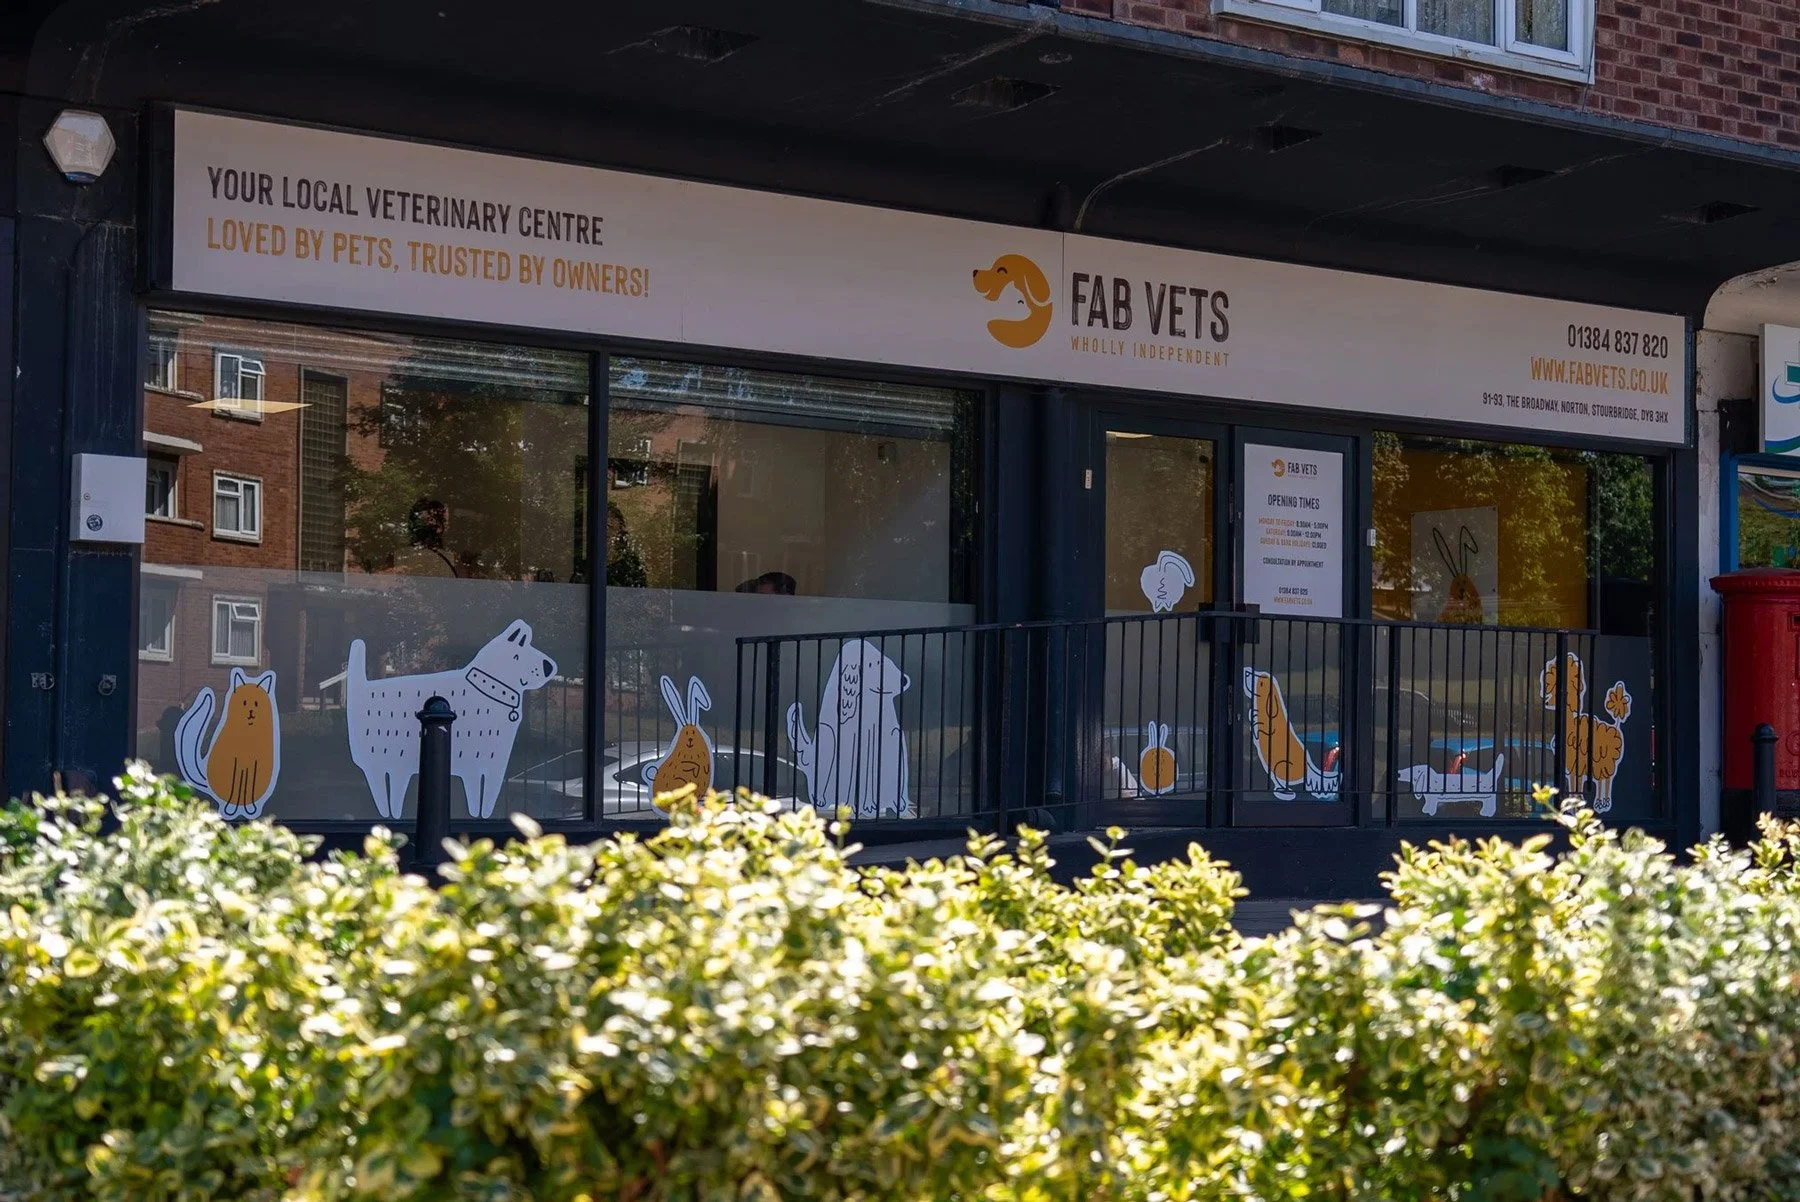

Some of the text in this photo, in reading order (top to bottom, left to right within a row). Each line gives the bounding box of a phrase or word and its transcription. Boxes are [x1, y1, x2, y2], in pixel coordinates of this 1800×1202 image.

[207, 166, 603, 246] YOUR LOCAL VETERINARY CENTRE
[207, 217, 649, 298] LOVED BY PETS, TRUSTED BY OWNERS!
[1072, 272, 1229, 343] FAB VETS
[1071, 336, 1230, 367] WHOLLY INDEPENDENT
[1568, 324, 1668, 359] 01384 837 820
[1531, 356, 1668, 395] WWW.FABVETS.CO.UK
[1506, 395, 1520, 408] THE
[1521, 396, 1560, 413] BROADWAY,
[1561, 400, 1590, 416] NORTON,
[1592, 405, 1639, 422] STOURBRIDGE,
[1641, 410, 1654, 422] DY8
[1655, 411, 1668, 423] 3HX
[1288, 462, 1318, 476] FAB VETS
[1268, 494, 1320, 510] OPENING TIMES
